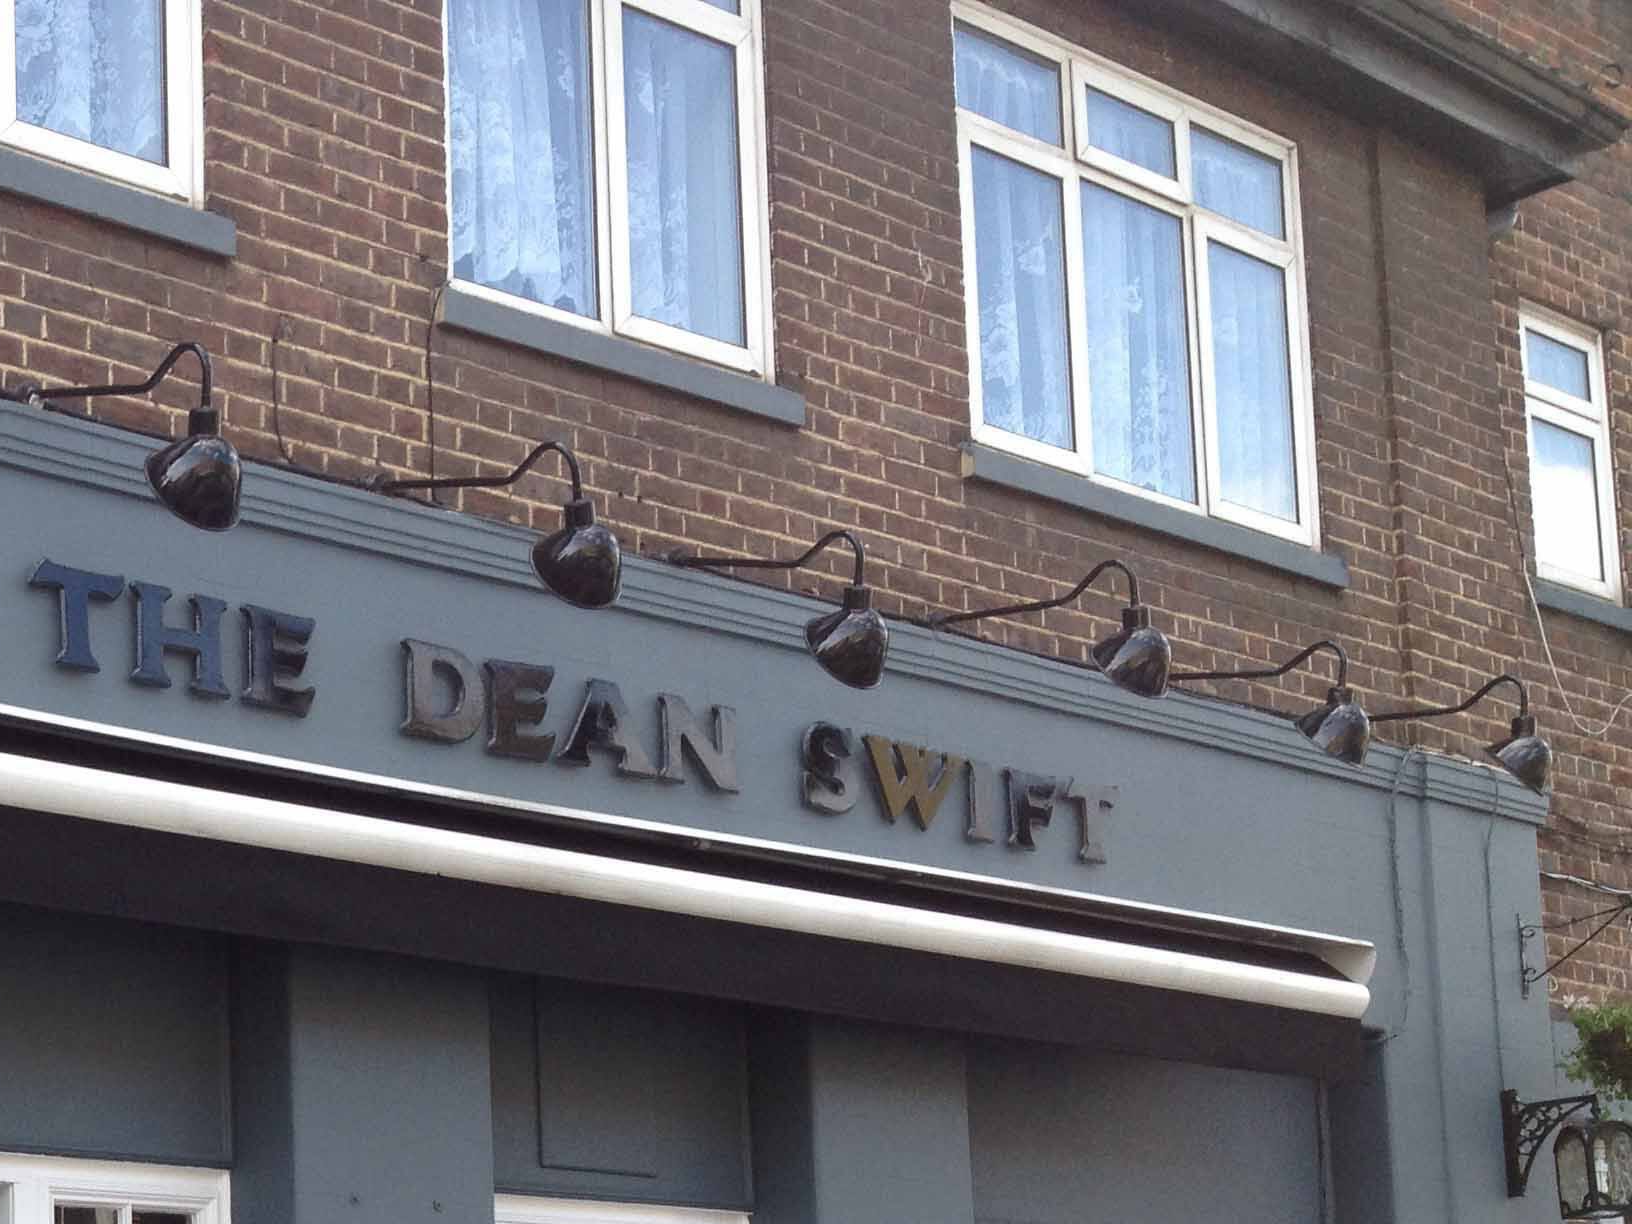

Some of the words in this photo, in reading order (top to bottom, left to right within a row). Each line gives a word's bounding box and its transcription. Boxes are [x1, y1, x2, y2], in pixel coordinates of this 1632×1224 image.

[27, 558, 317, 719] THE
[399, 638, 739, 794] DEAN
[800, 721, 1118, 864] SWIFT
